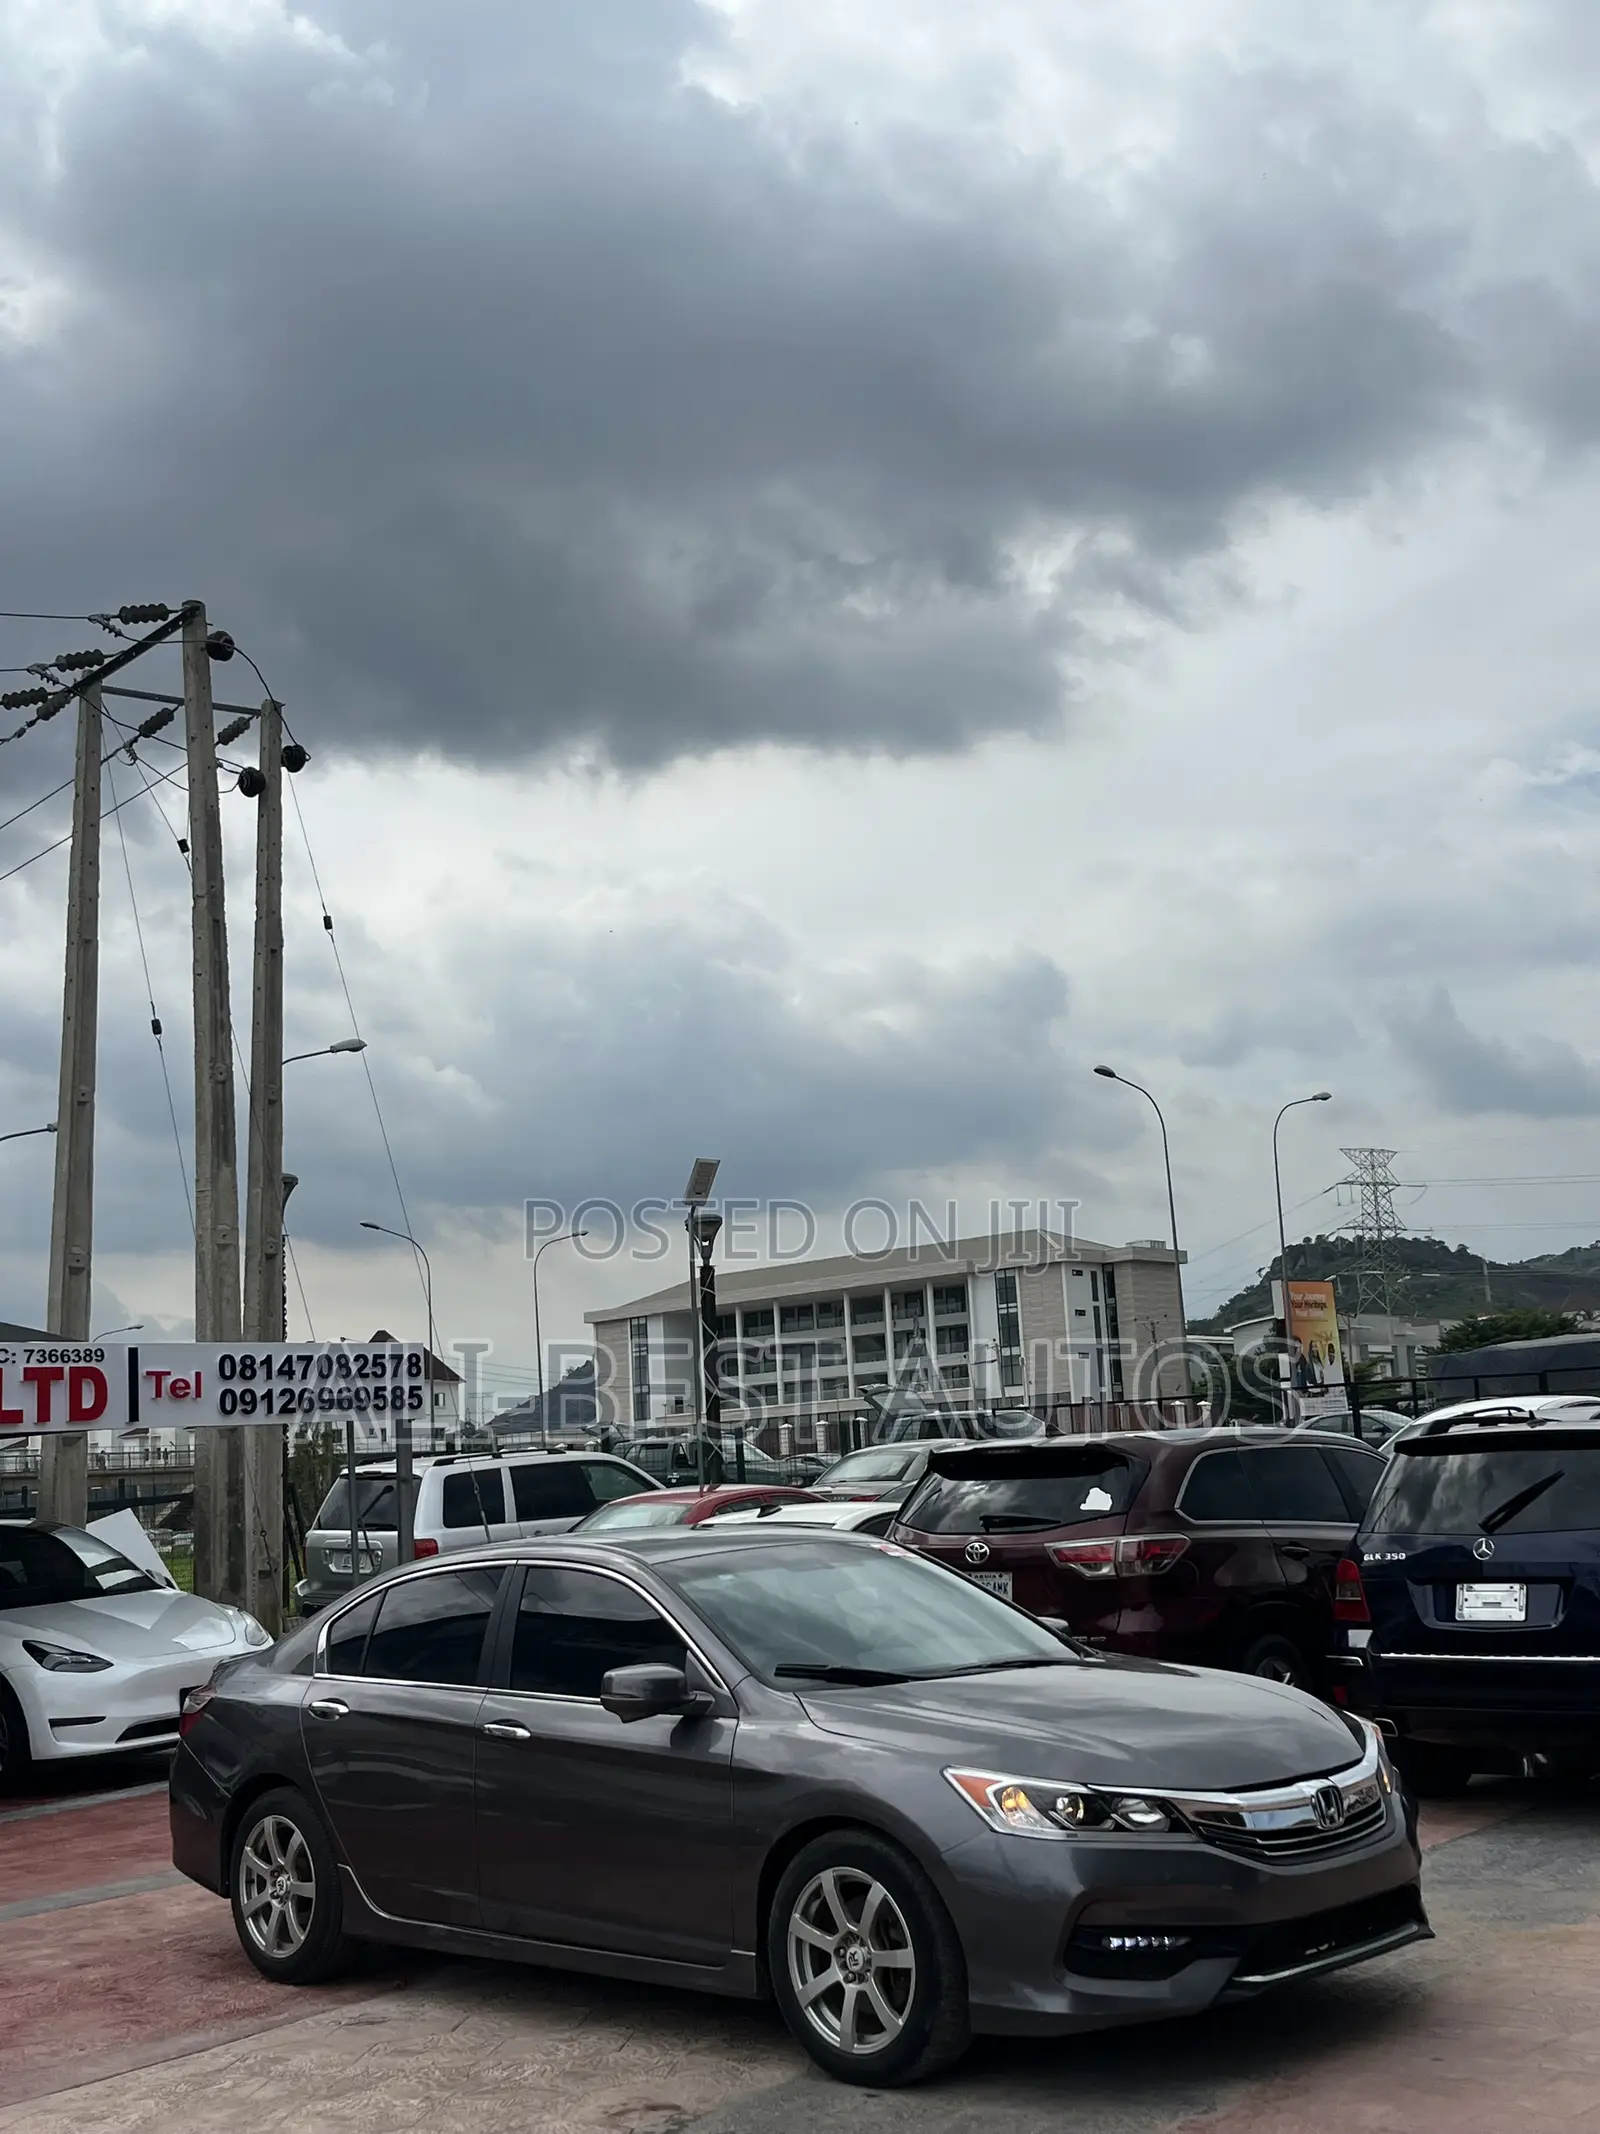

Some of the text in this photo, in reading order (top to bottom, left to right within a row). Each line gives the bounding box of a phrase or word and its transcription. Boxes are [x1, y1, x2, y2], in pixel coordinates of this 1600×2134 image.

[24, 1348, 105, 1363] 7366389
[218, 1353, 422, 1381] 08147082578
[0, 1366, 108, 1424] LTD
[145, 1370, 202, 1399] Tel
[219, 1385, 423, 1415] 09126969585
[1363, 1552, 1406, 1561] GLK 350
